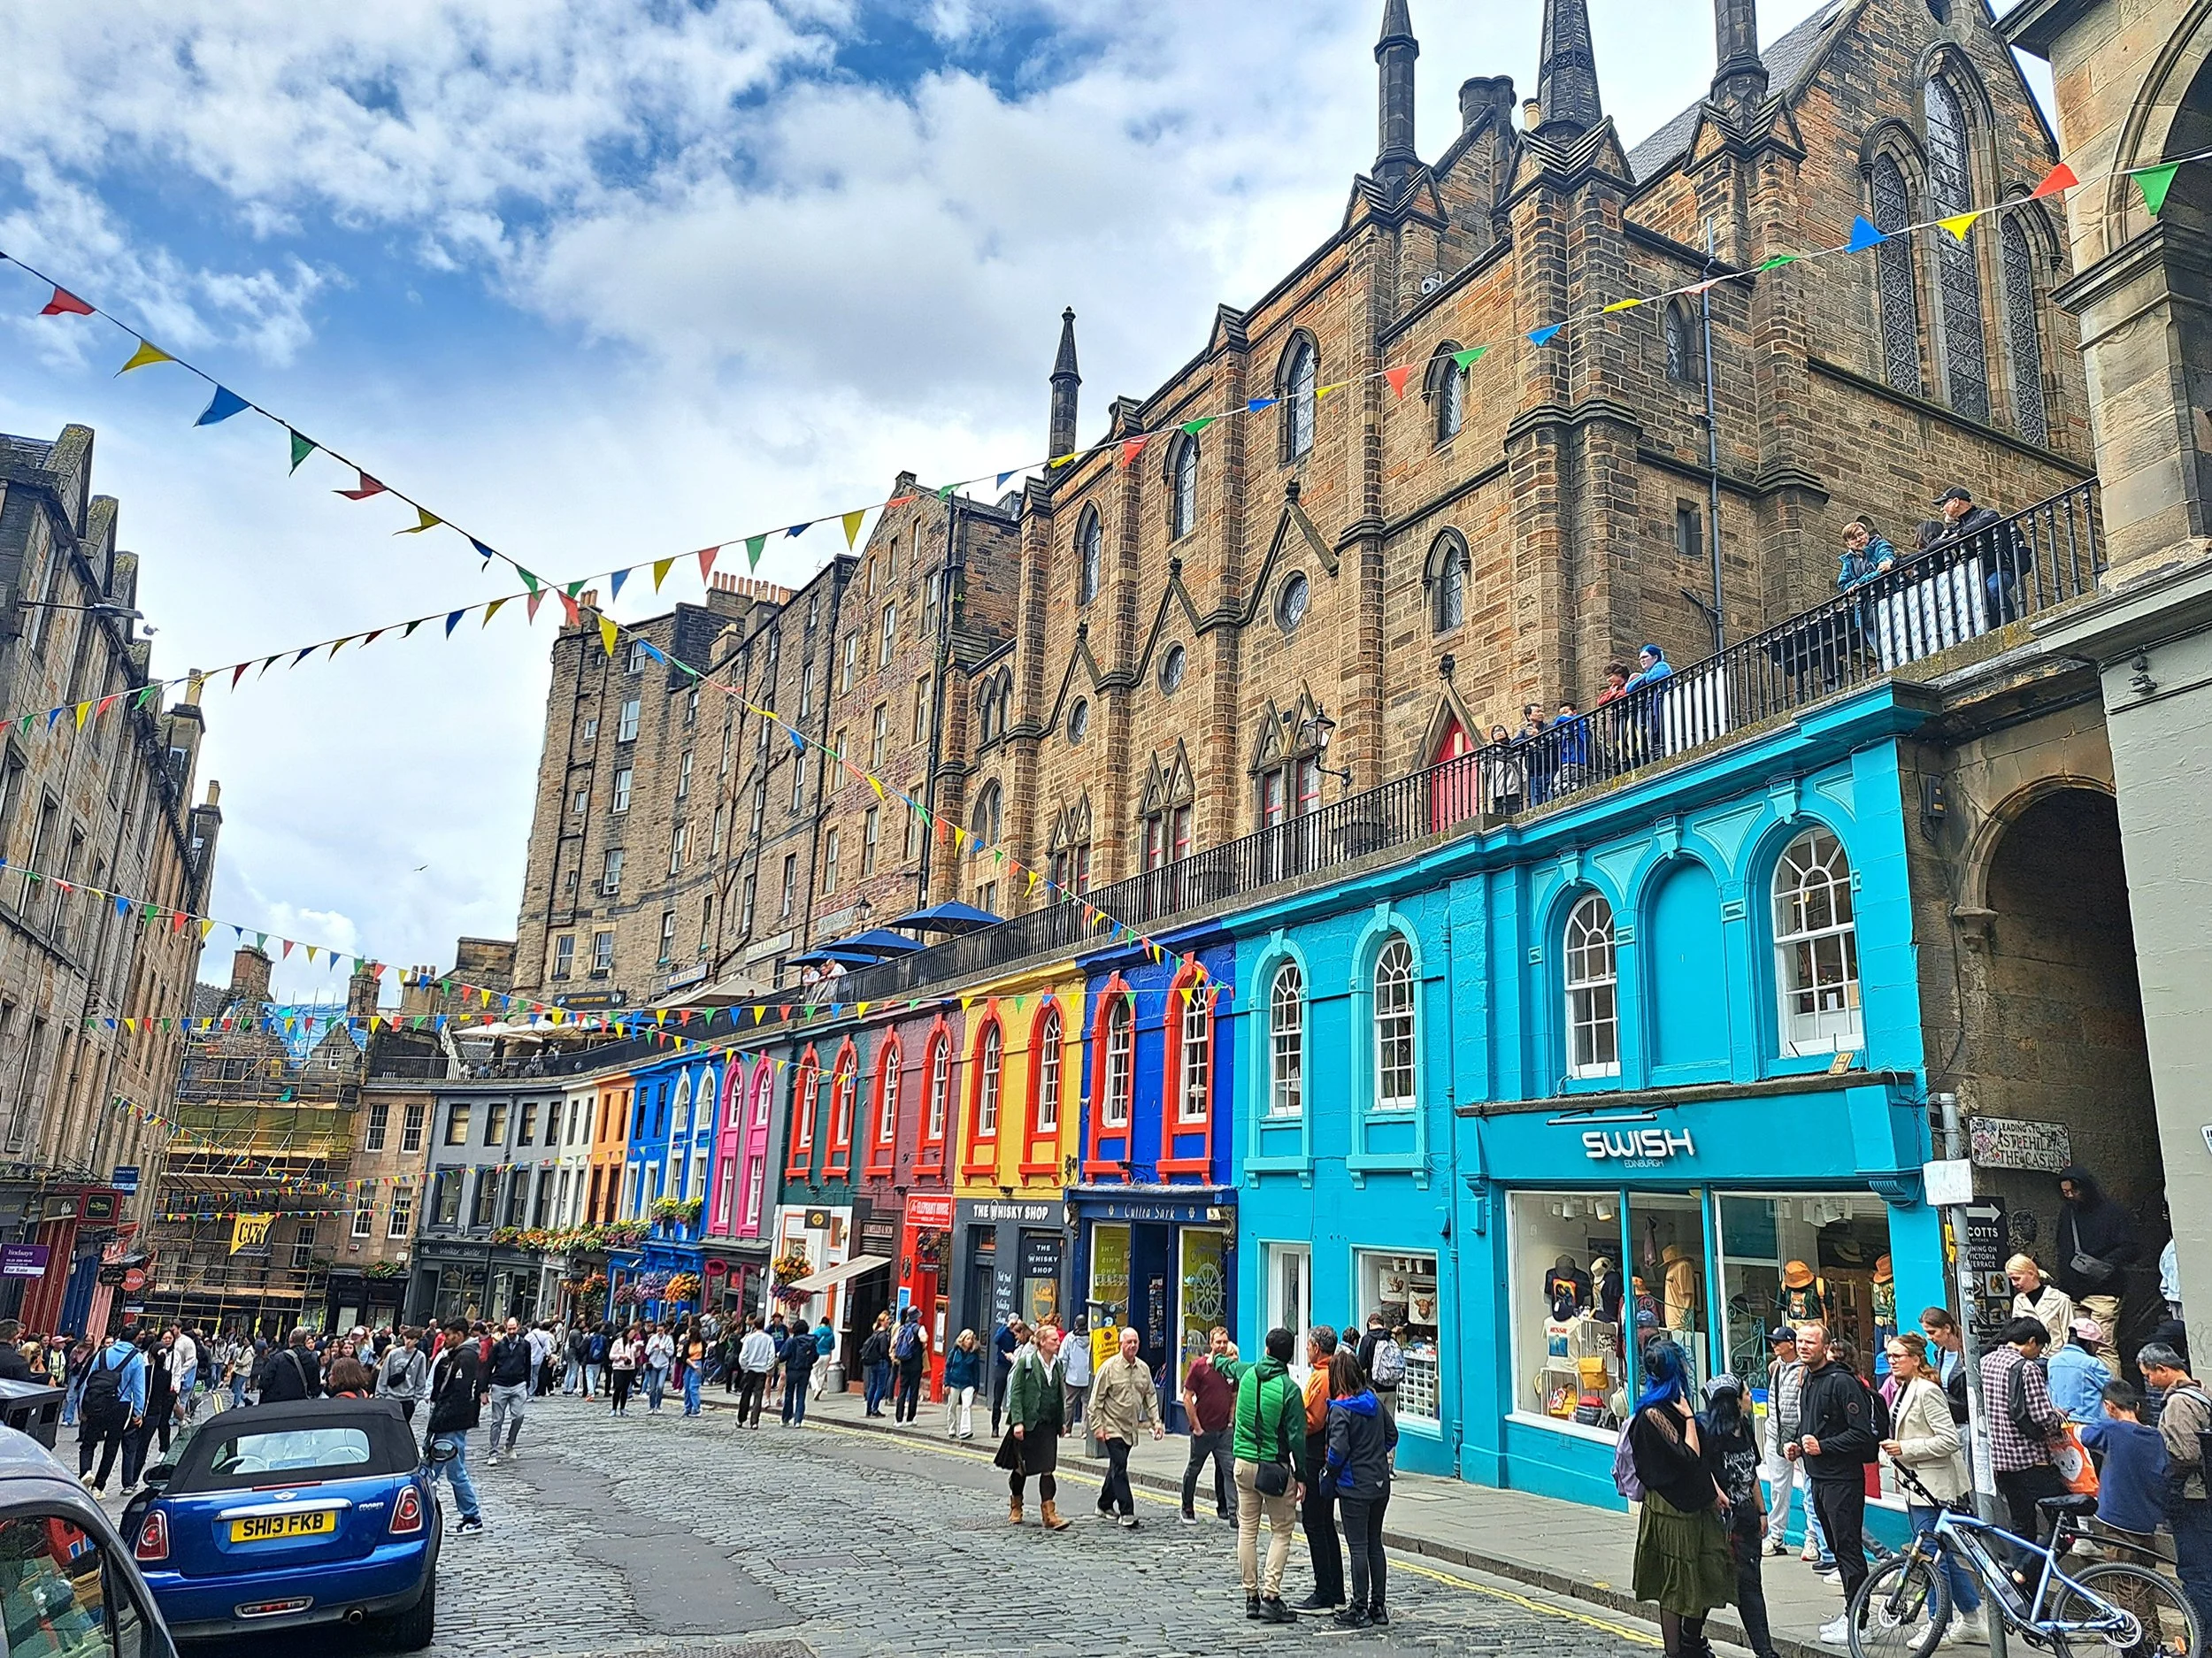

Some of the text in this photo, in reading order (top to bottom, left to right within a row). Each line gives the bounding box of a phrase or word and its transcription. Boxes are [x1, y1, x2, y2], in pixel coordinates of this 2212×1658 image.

[1999, 1122, 2041, 1134] LEADING TO
[1581, 1128, 1694, 1158] SWISH
[1996, 1134, 2053, 1152] ASTLEHILL
[1624, 1159, 1664, 1169] EDINBURGH
[2001, 1150, 2020, 1165] THE
[973, 1203, 1048, 1220] THE WHISKY SHOP
[1154, 1204, 1175, 1219] Sark
[238, 1222, 270, 1244] CITY
[1968, 1226, 1999, 1238] COTTS
[358, 1501, 384, 1511] COOPER
[243, 1513, 325, 1537] SH13 FKB
